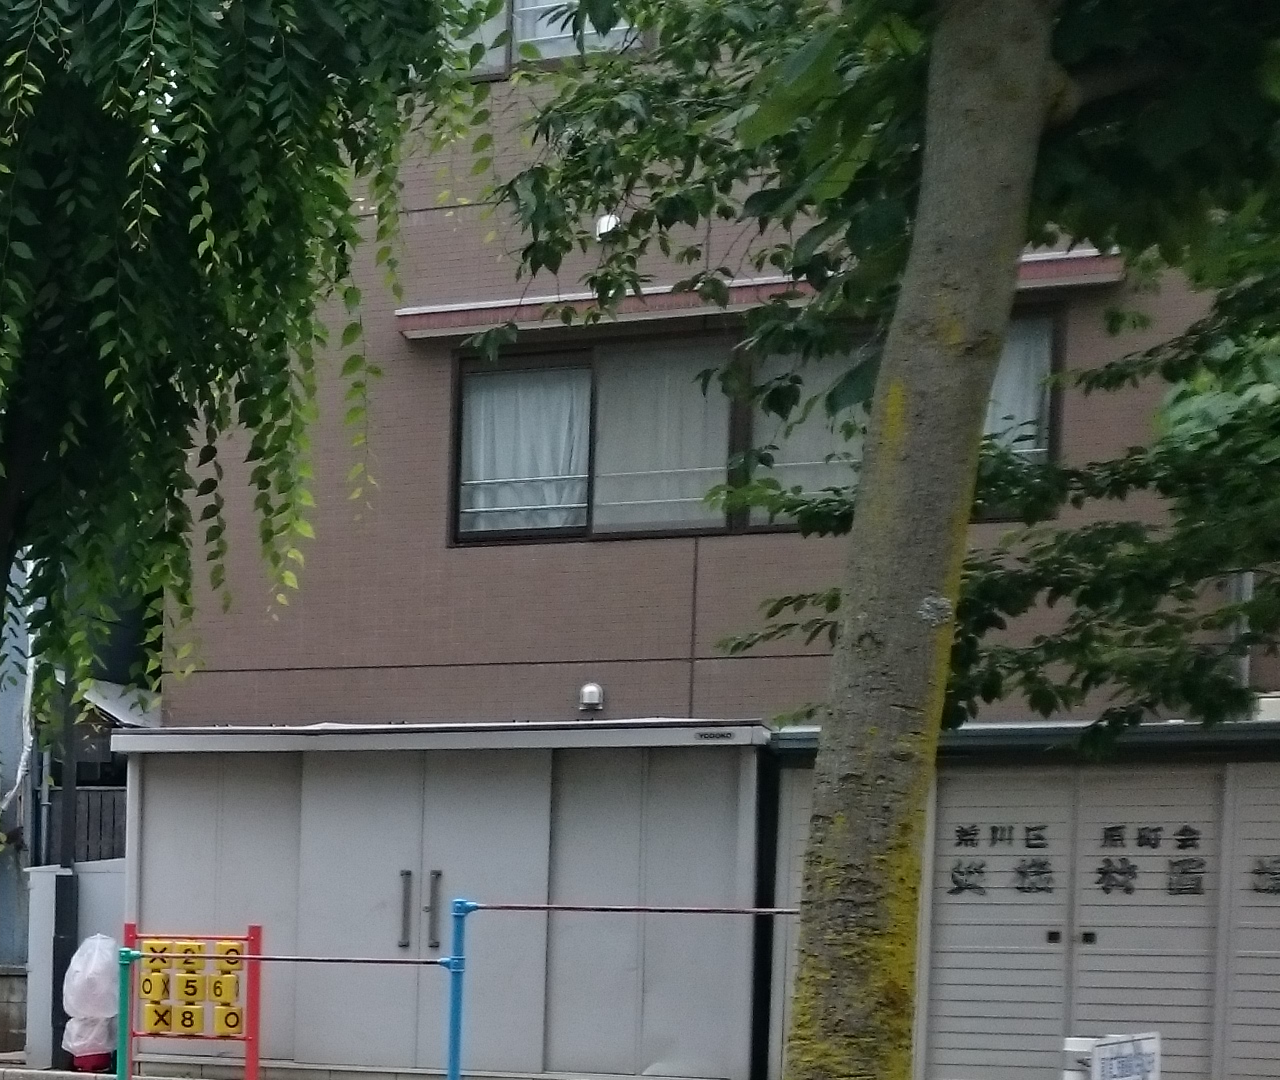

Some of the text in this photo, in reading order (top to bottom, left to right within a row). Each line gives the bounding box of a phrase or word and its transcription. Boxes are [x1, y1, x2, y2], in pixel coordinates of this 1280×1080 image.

[184, 979, 198, 997] 5
[213, 980, 223, 998] 6
[181, 1010, 195, 1028] 8
